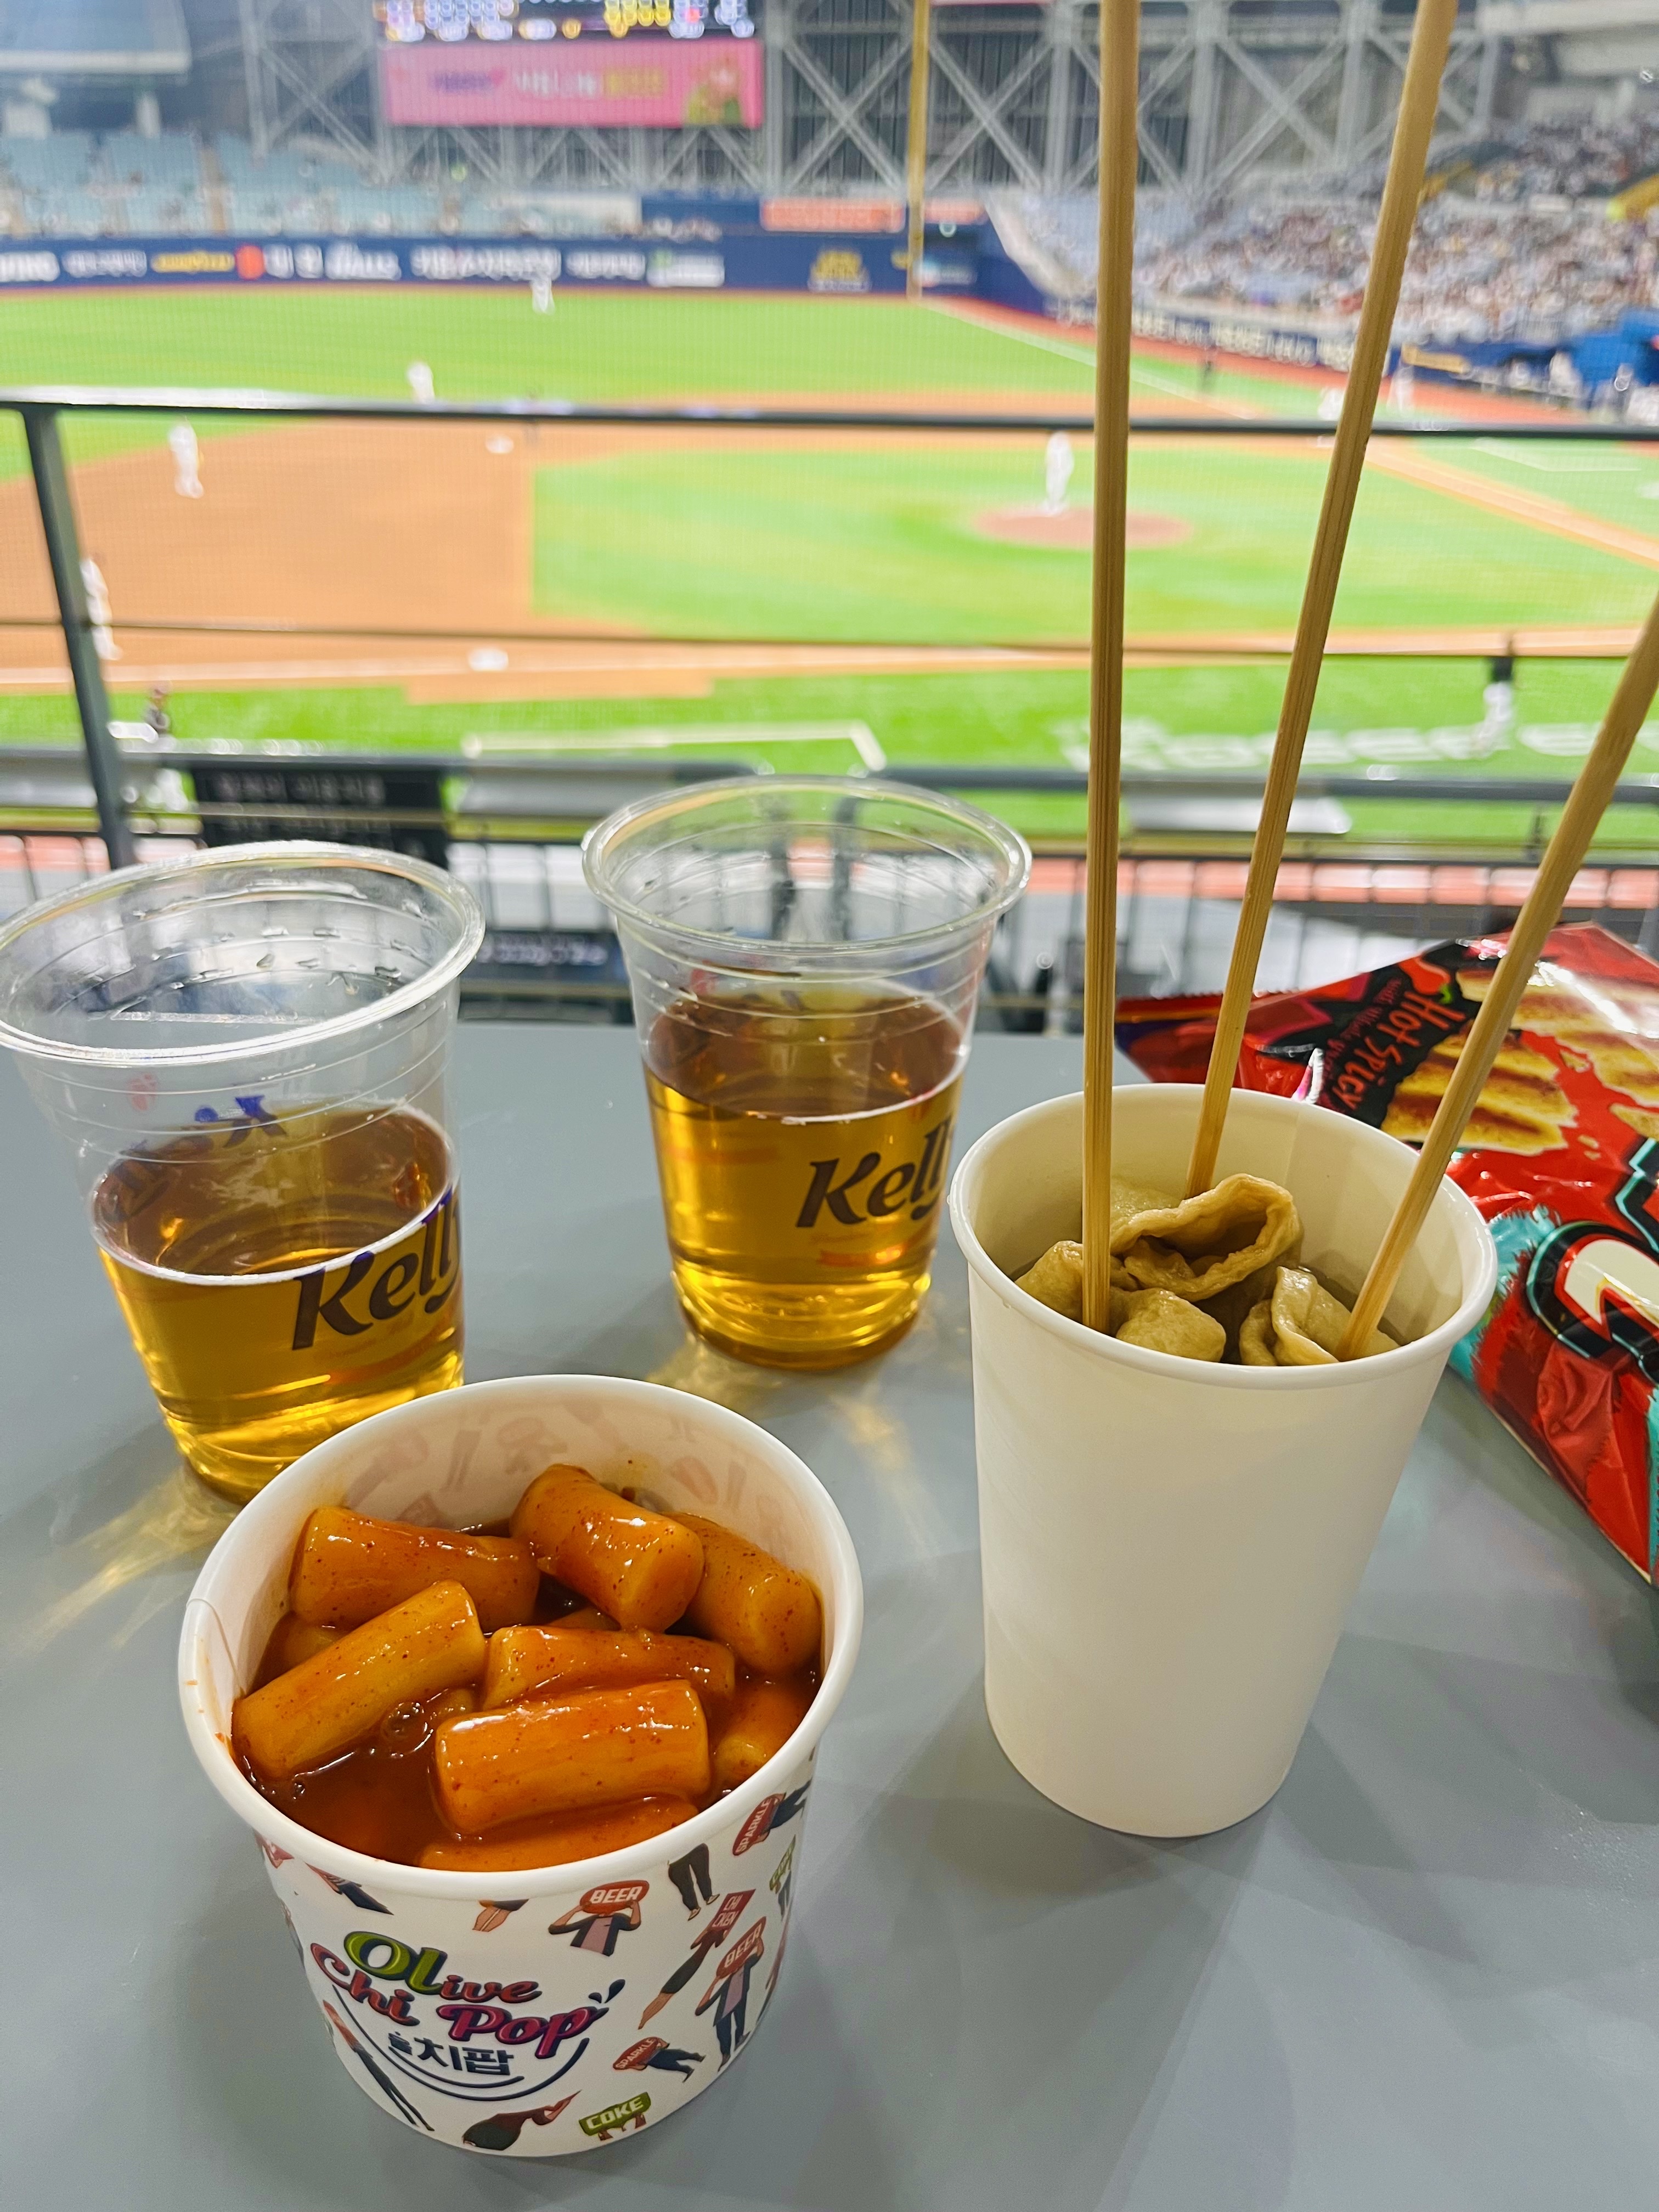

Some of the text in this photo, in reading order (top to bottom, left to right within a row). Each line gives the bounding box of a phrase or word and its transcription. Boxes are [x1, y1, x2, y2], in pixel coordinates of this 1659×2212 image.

[736, 1798, 772, 1853] SPARKLE
[591, 1884, 644, 1904] BEER
[723, 1894, 743, 1911] CHI
[724, 1922, 763, 1968] BEER
[344, 1931, 542, 2004] Olive
[311, 1943, 608, 2058] Chi Pop
[615, 2038, 655, 2069] SPARKLE
[585, 2096, 644, 2129] COKE
